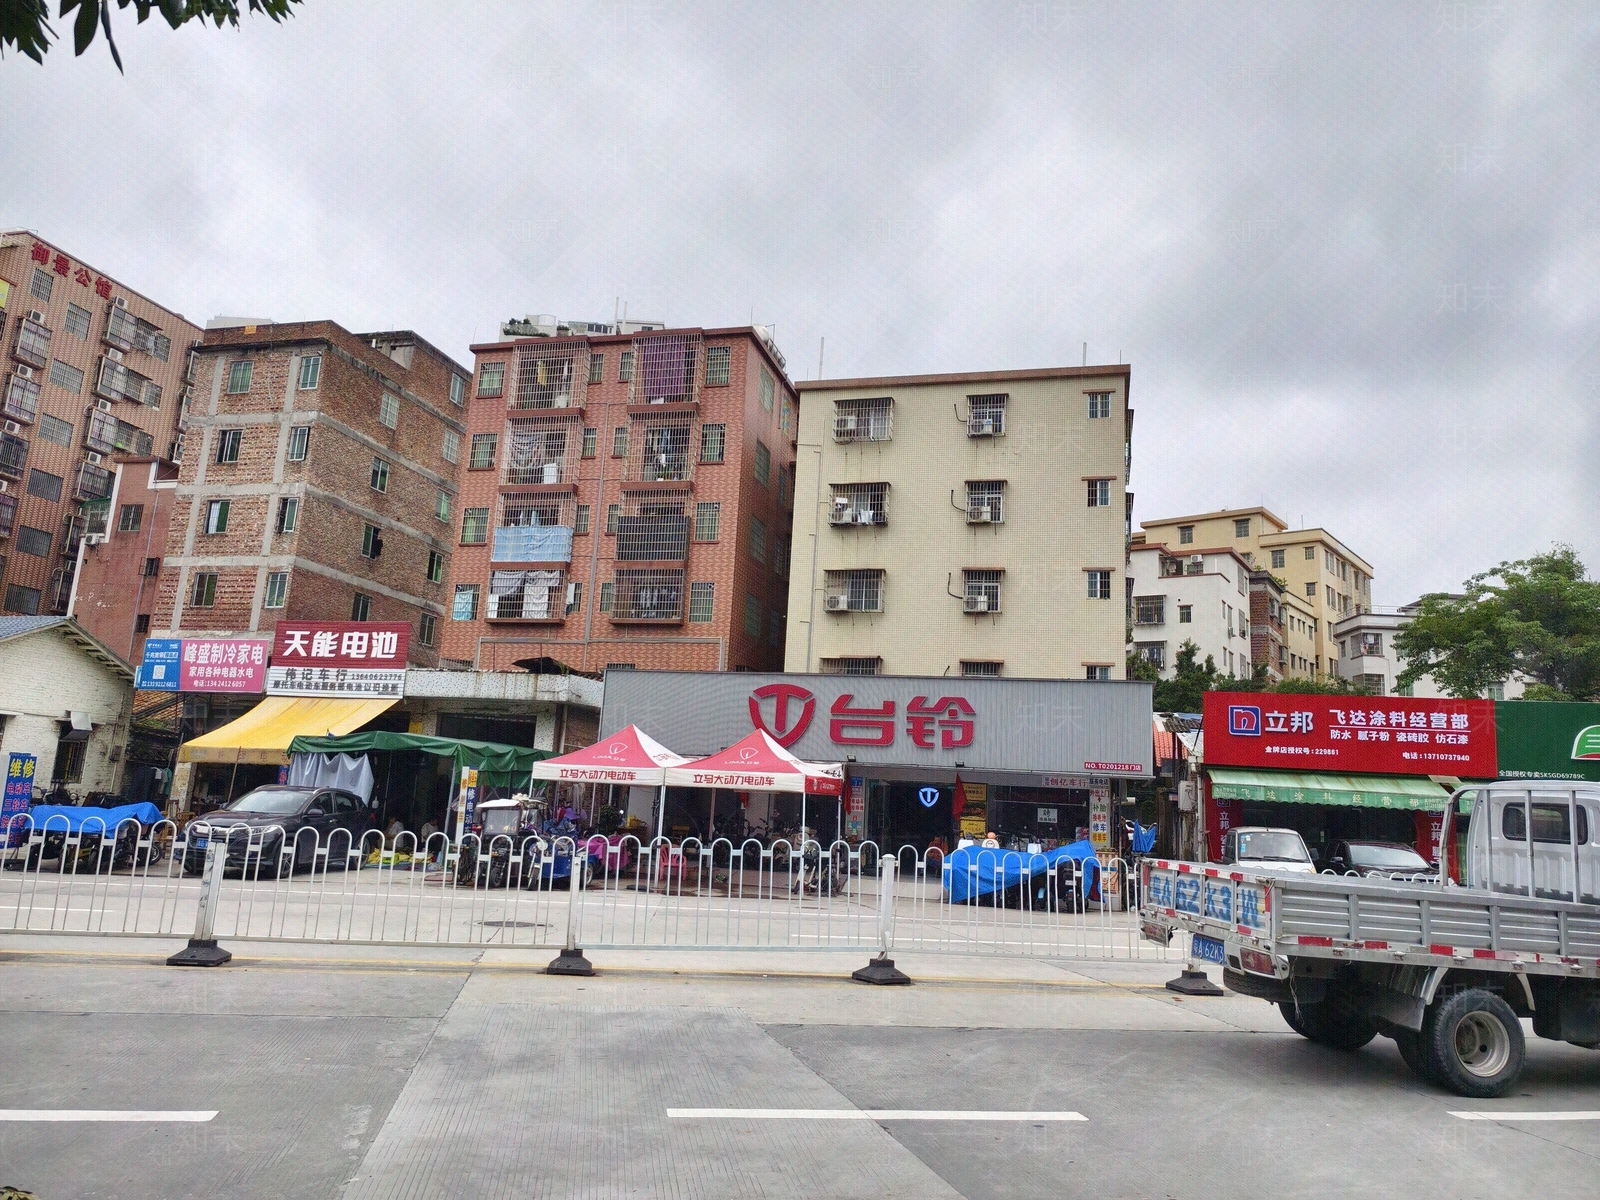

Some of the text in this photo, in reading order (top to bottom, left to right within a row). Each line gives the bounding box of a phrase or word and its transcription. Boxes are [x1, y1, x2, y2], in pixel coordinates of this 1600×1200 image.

[31, 242, 112, 300] 御景公馆
[282, 630, 398, 658] 天能电池
[183, 643, 263, 665] 峰盛制冷家电
[189, 666, 254, 678] 家用各种电器水电
[285, 668, 348, 681] 伟记车行
[351, 673, 402, 681] 13640623776
[830, 693, 976, 749] 台铃
[1265, 710, 1314, 734] 立邦
[1329, 709, 1469, 729] 飞达涂料经营部
[1330, 730, 1469, 744] 防水 腻子粉 瓷砖胶 仿石漆
[9, 758, 36, 778] 维修
[560, 769, 637, 780] 立马大动力电动车
[7, 781, 31, 795] 电动车
[693, 774, 775, 786] 立马大动力电动车
[3, 798, 28, 811] 三轮车
[1241, 788, 1419, 807] 飞达涂料经营部
[1220, 811, 1230, 829] 立邦
[1430, 822, 1441, 841] 立邦
[1193, 938, 1227, 964] 粤A62K3
